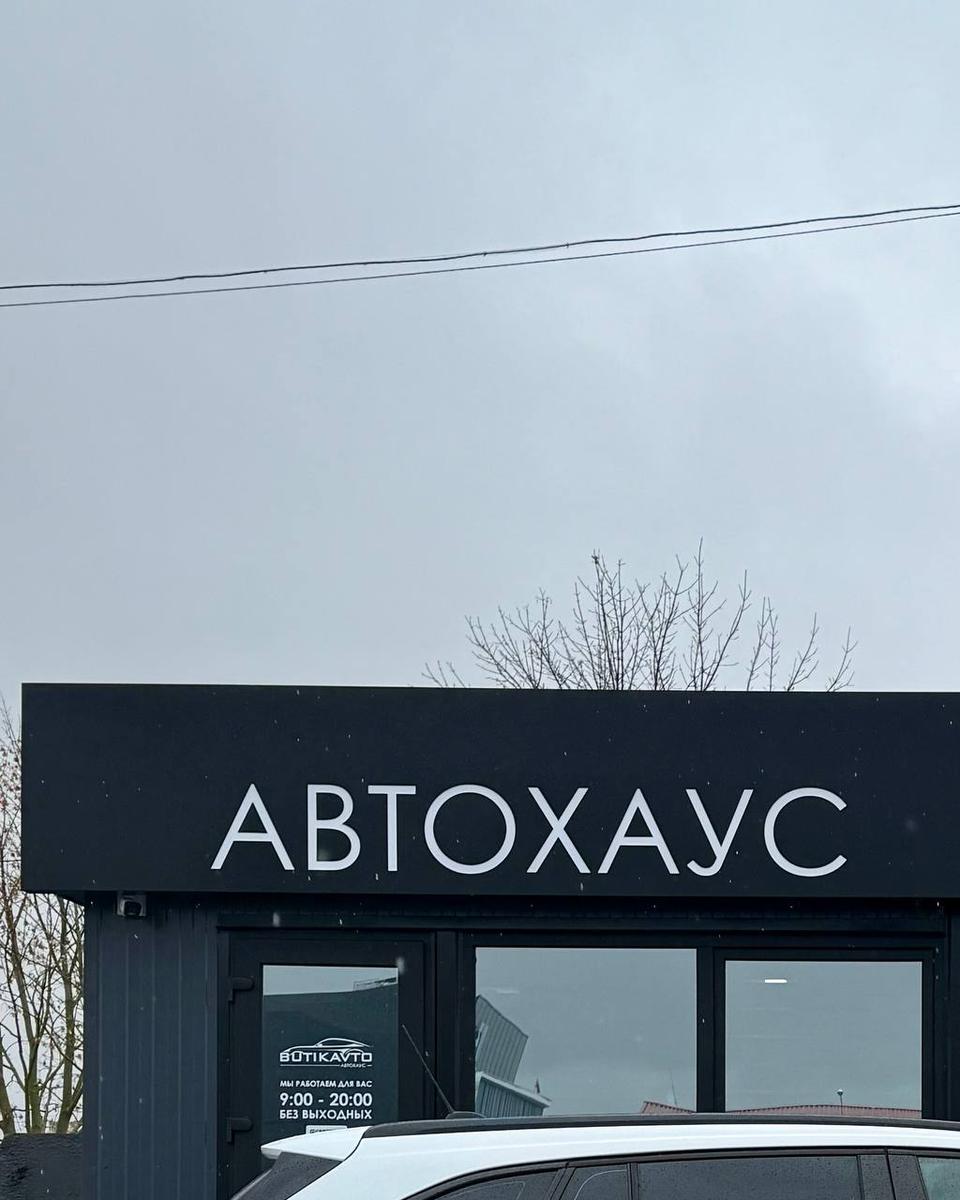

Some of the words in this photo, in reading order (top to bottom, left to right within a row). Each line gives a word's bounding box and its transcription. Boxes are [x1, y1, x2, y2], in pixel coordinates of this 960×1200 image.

[211, 782, 848, 879] АВТОХАУС
[280, 1052, 372, 1062] BUTIKAVTO
[280, 1080, 294, 1088] МЫ
[295, 1080, 337, 1088] РАБОТАЕМ
[337, 1080, 355, 1089] ДЛЯ
[355, 1080, 373, 1088] ВАС
[279, 1092, 313, 1107] 9:00
[329, 1092, 373, 1107] 20:00
[280, 1110, 299, 1120] БЕЗ
[302, 1110, 373, 1121] ВЫХОДНЫХ
